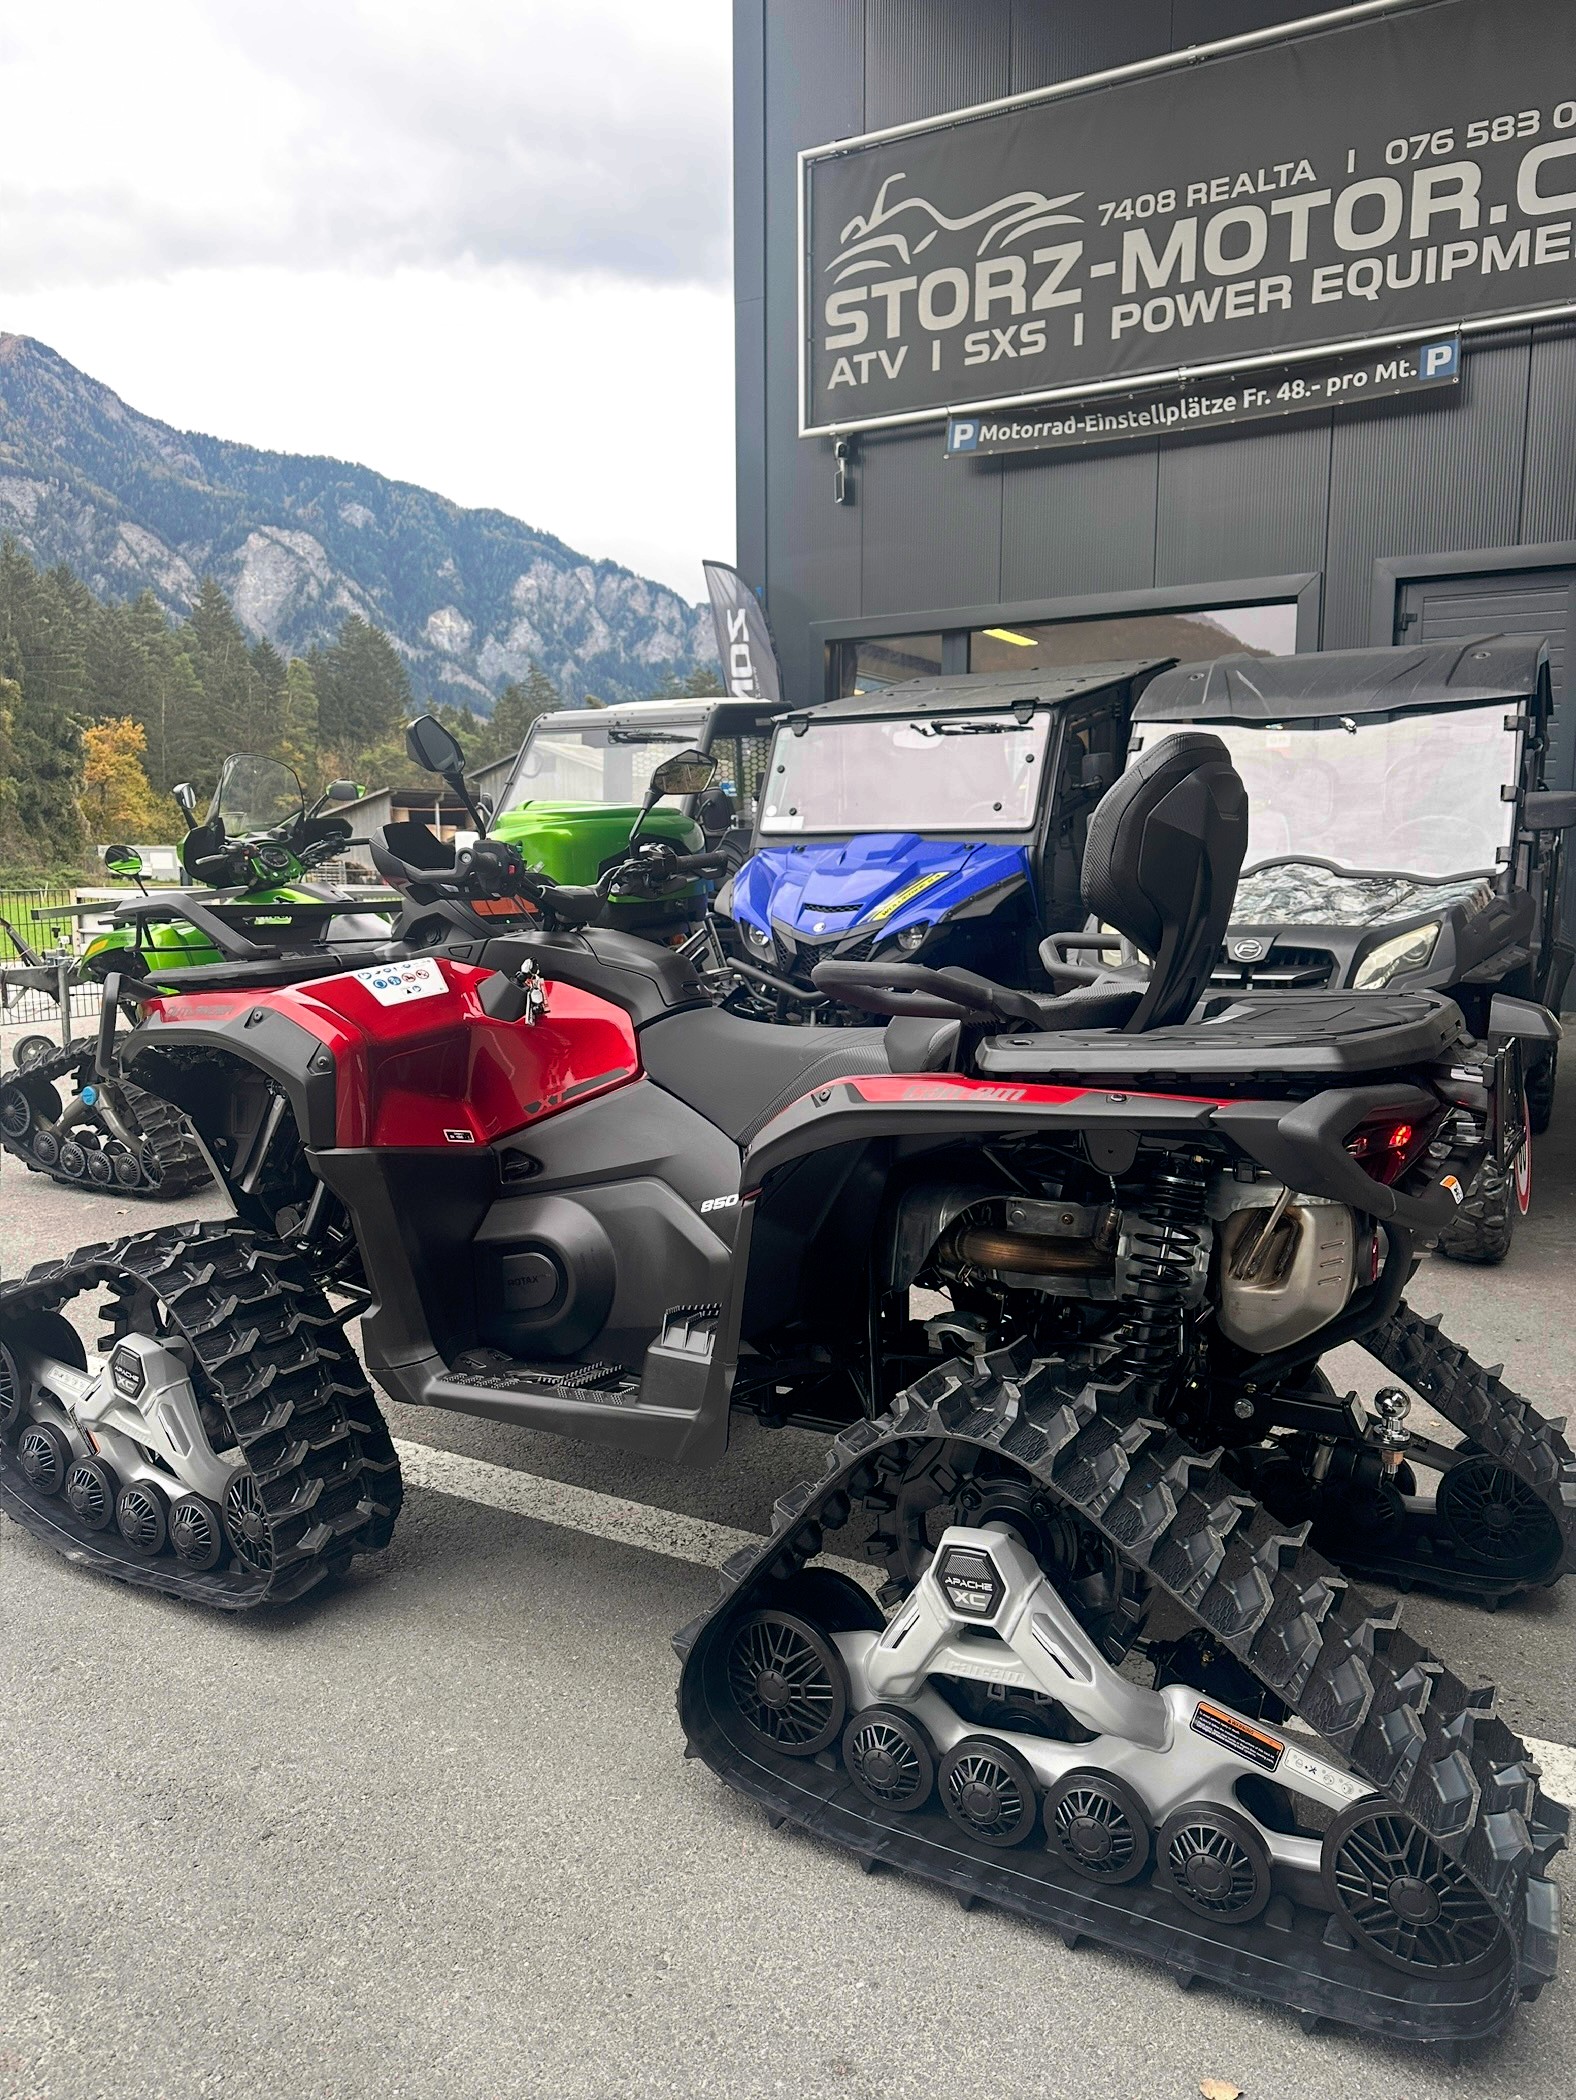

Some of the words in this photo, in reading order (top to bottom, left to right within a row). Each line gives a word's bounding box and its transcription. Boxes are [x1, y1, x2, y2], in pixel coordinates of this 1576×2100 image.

[1098, 189, 1177, 227] 7408
[1187, 159, 1317, 207] REALTA
[1385, 128, 1455, 165] 076
[1466, 109, 1541, 148] 583
[824, 137, 1576, 350] STORZ-MOTOR.C
[827, 345, 909, 390] ATV
[964, 320, 1046, 366] SXS
[1111, 274, 1293, 340] POWER
[1311, 221, 1576, 304] EQUIPME
[953, 424, 975, 449] P
[978, 395, 1237, 442] Motorrad-Einstellplätze
[1243, 387, 1271, 408] Fr.
[1277, 379, 1321, 401] 48.-
[1327, 371, 1367, 396] pro
[1375, 359, 1417, 383] Mt.
[1426, 346, 1453, 376] P
[700, 1193, 739, 1213] 850
[114, 1365, 140, 1383] APACHE
[117, 1375, 135, 1391] XC
[944, 1576, 993, 1592] APACHE
[954, 1589, 986, 1607] XC
